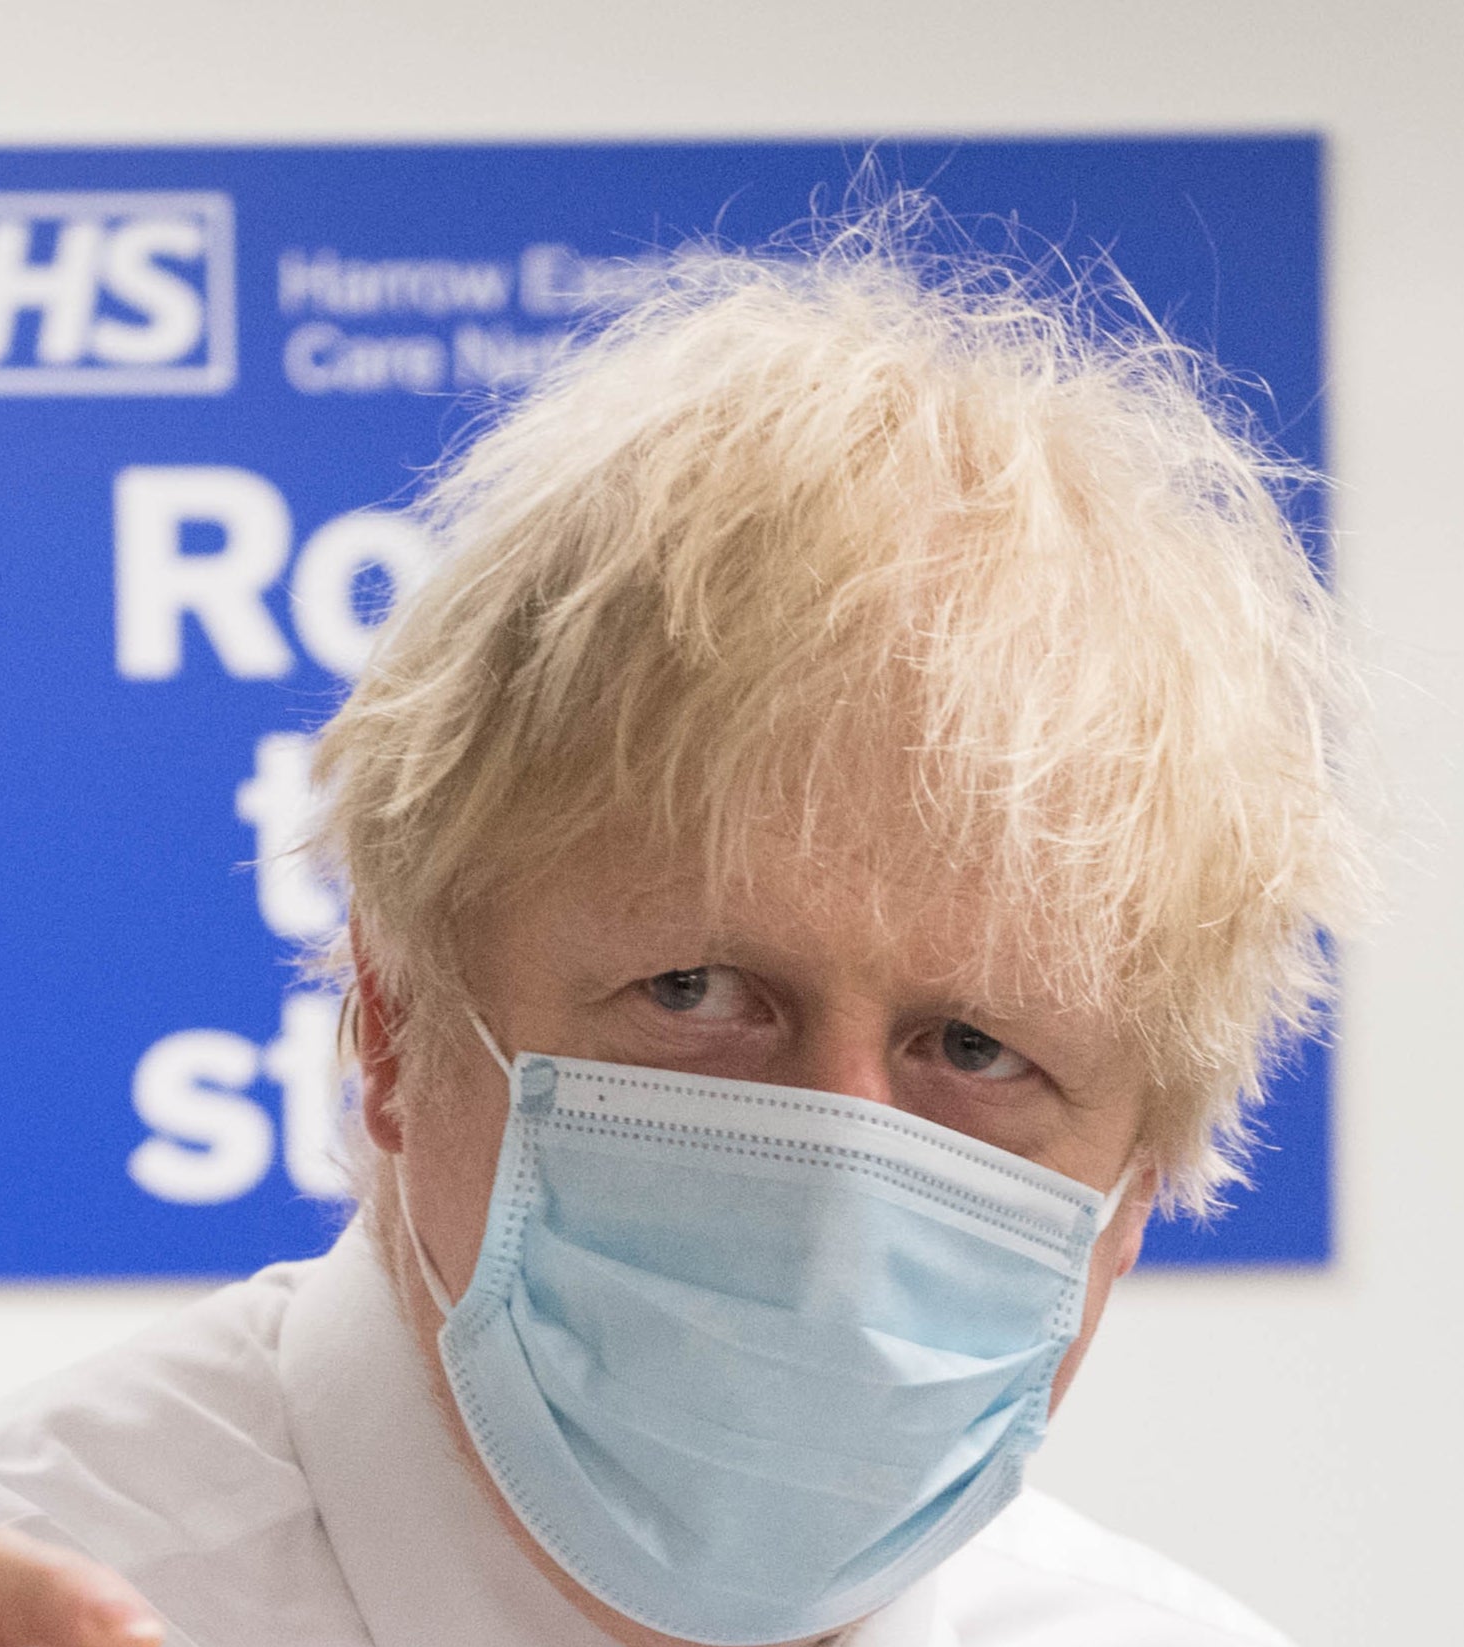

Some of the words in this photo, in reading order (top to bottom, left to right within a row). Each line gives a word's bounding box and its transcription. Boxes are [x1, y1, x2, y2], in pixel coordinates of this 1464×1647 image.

[278, 250, 509, 315] Harrow
[285, 323, 446, 392] Care
[113, 464, 433, 682] Ro
[127, 990, 357, 1205] st
